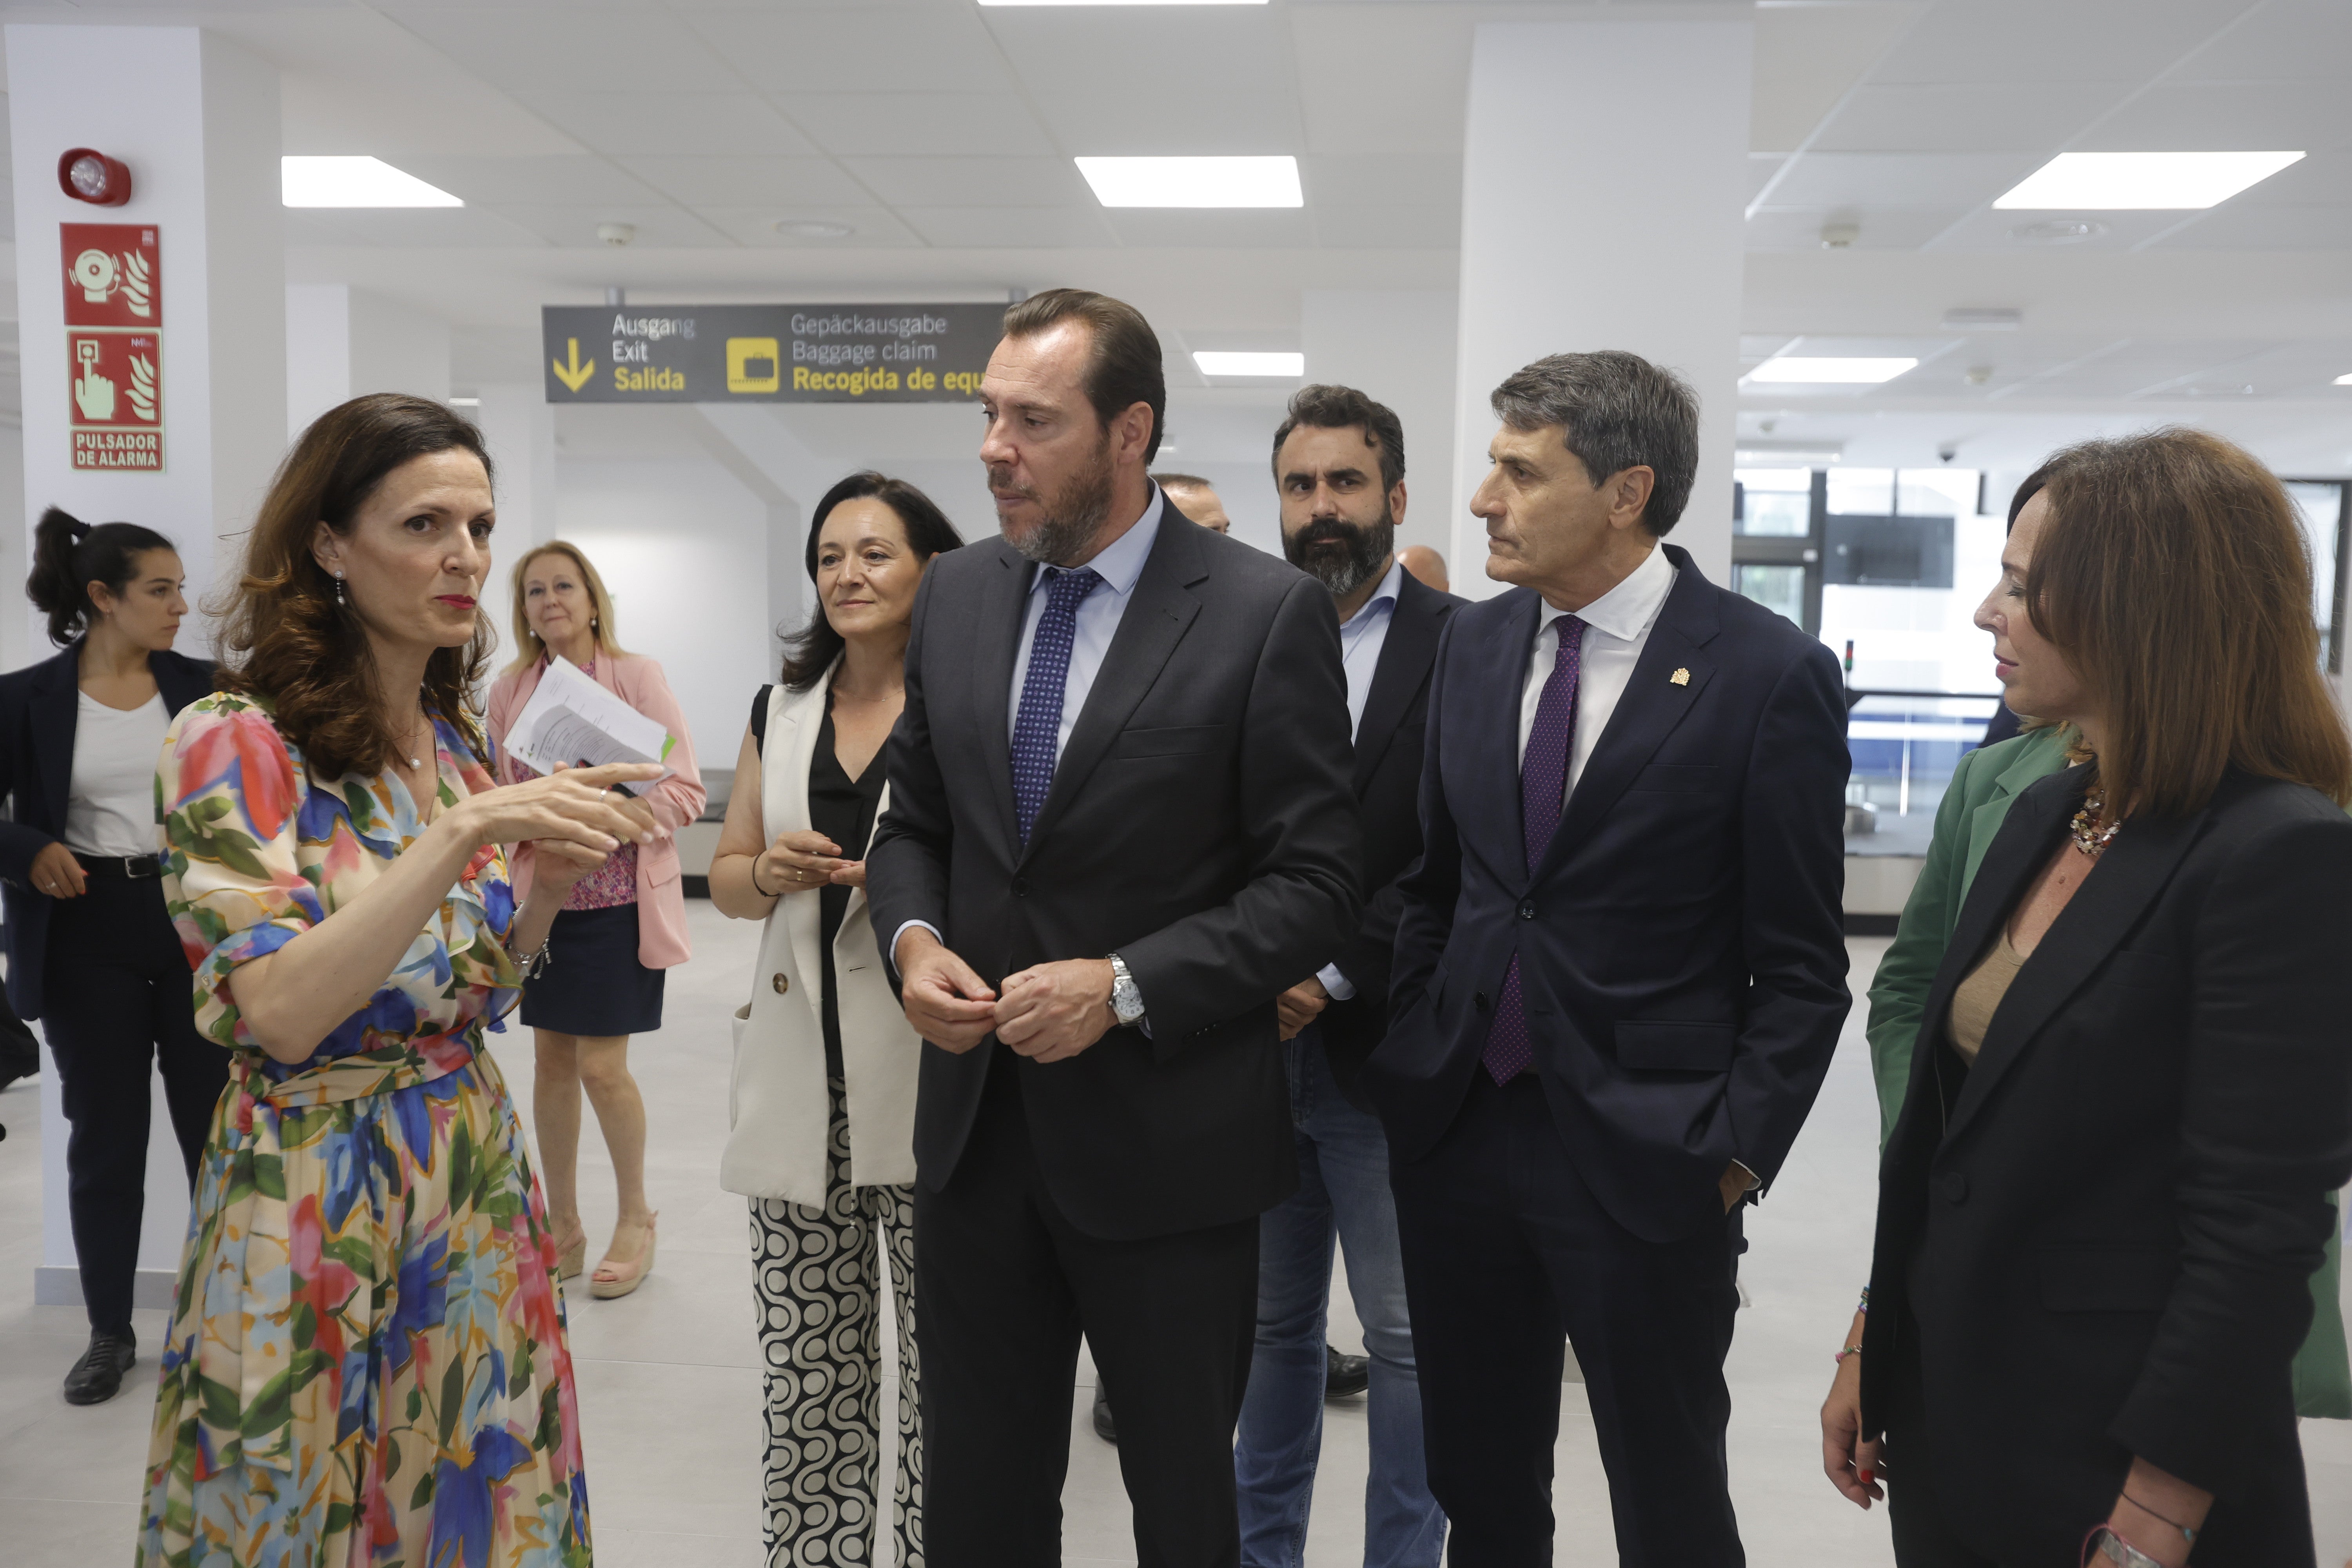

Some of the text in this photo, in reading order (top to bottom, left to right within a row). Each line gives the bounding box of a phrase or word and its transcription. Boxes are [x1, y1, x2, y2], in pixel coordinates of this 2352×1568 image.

[612, 314, 696, 341] Ausgang
[791, 313, 947, 338] Gepäckausgabe
[612, 340, 649, 363] Exit
[793, 340, 936, 365] Baggage claim
[614, 367, 684, 391] Salida
[793, 366, 899, 396] Recogida
[907, 366, 936, 390] de
[76, 433, 156, 450] PULSADOR
[77, 450, 156, 466] DE ALARMA
